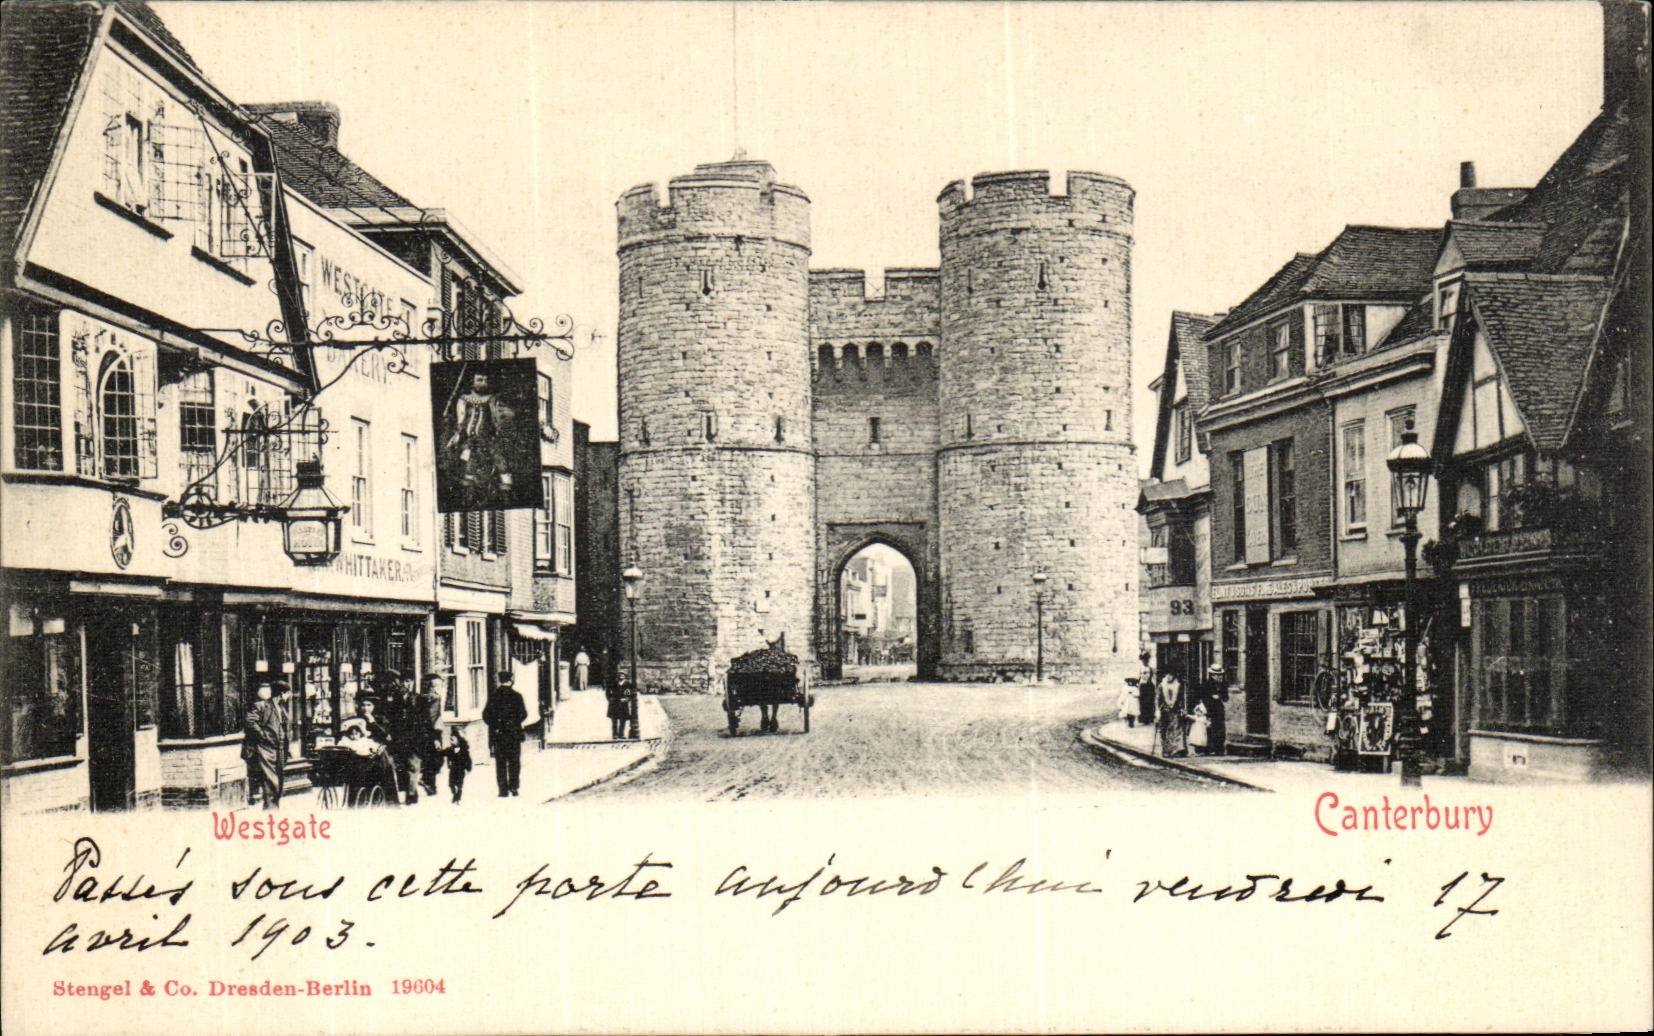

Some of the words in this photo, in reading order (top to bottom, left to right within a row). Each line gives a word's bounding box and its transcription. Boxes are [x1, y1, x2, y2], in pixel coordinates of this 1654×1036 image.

[321, 255, 393, 321] WESTGATE
[1171, 600, 1195, 616] 93
[232, 867, 345, 900] sous
[366, 858, 483, 902] cette
[492, 852, 673, 920] porte
[1133, 858, 1392, 903] vendredi
[1433, 871, 1505, 940] 17
[43, 913, 192, 956] avril
